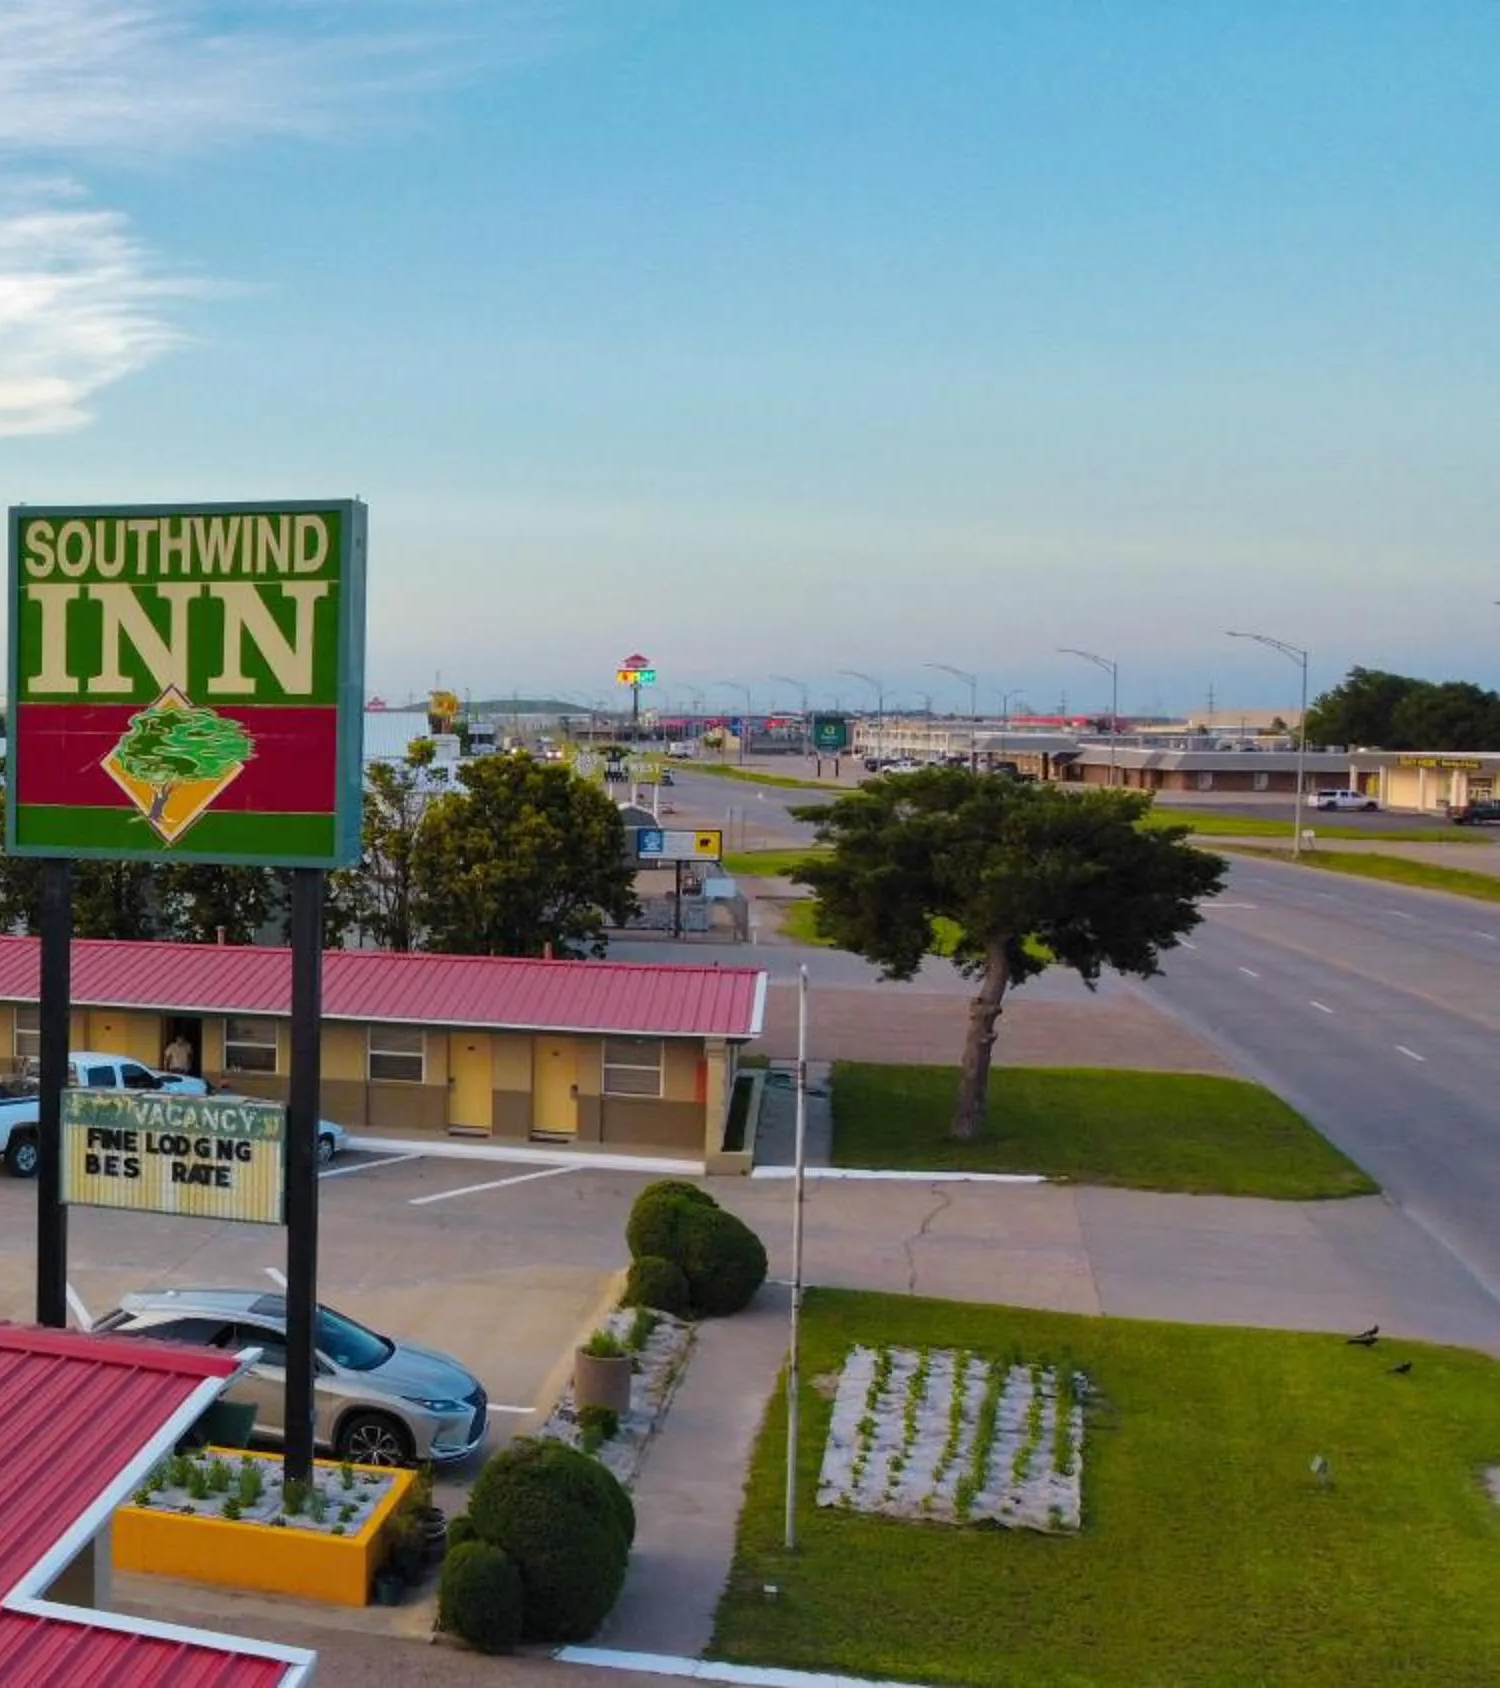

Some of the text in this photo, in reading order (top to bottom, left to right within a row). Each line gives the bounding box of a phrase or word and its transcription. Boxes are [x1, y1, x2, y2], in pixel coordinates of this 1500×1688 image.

[25, 514, 329, 577] SOUTHWIND
[28, 582, 328, 694] INN
[134, 1102, 256, 1132] VACANCY
[85, 1154, 231, 1187] BES RATE
